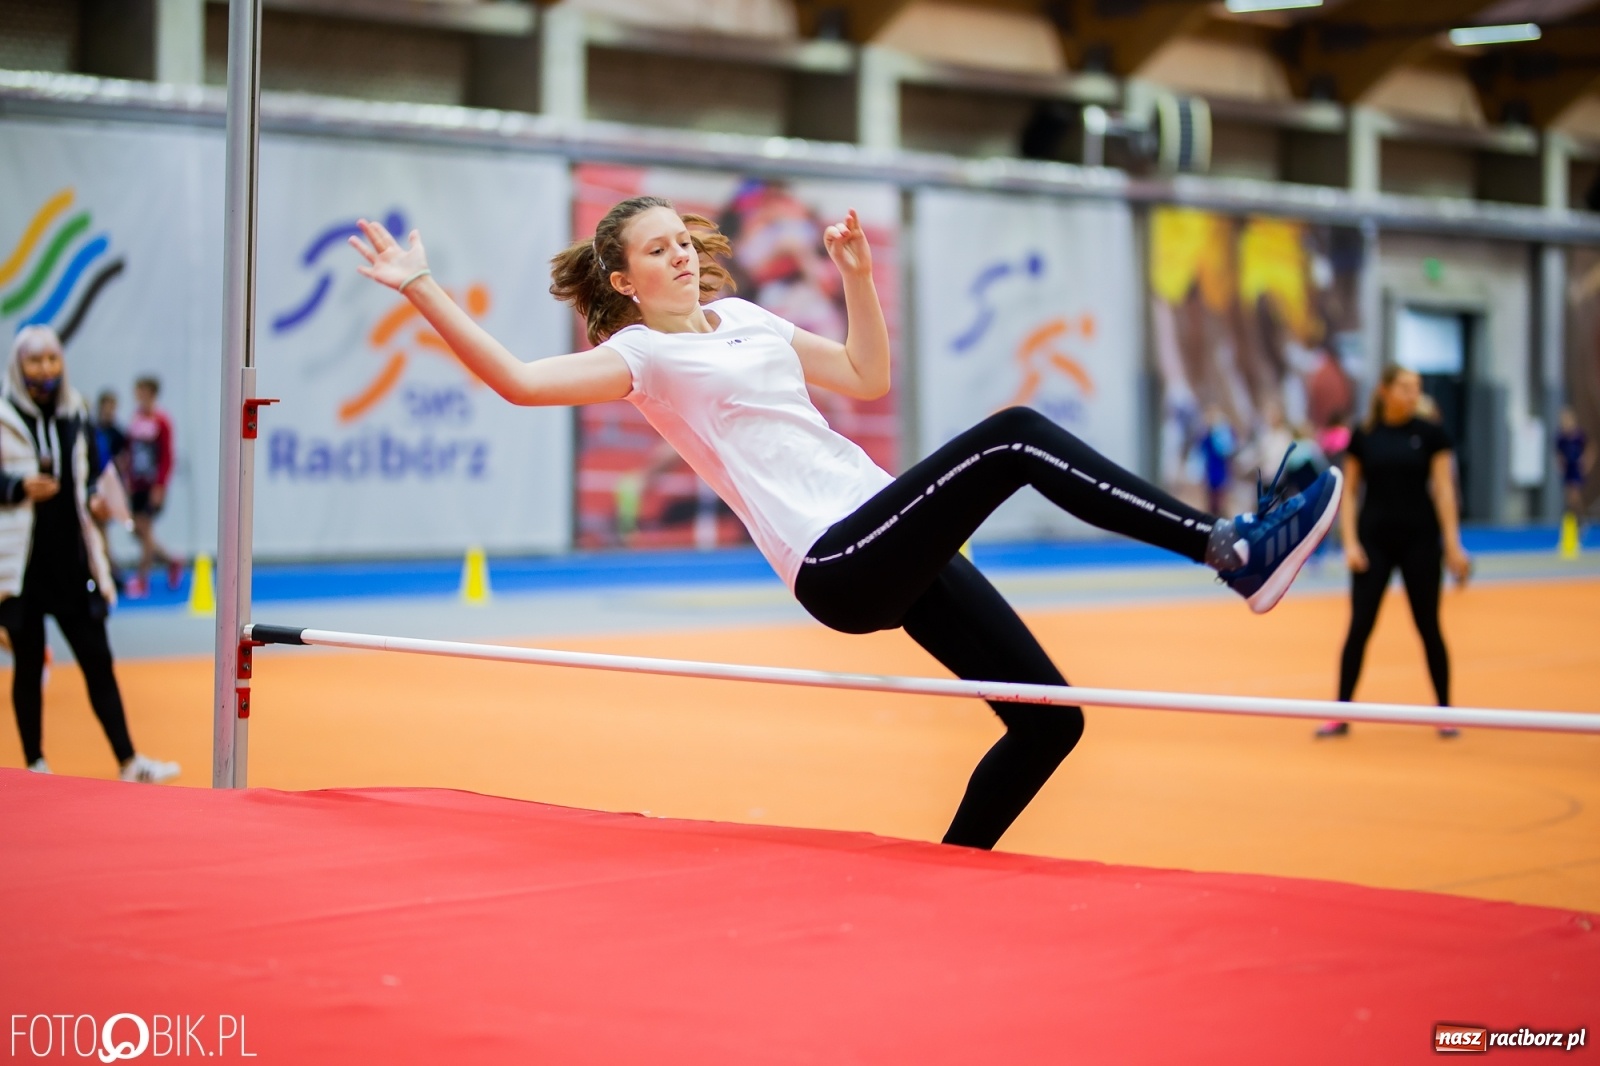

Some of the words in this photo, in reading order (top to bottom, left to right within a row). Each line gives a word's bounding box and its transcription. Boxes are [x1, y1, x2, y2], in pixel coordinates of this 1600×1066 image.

[936, 452, 982, 487] SPORTSWEAR
[1024, 444, 1071, 471] SPORTSWEAR
[1111, 487, 1156, 512] SPORTSWEAR
[856, 514, 899, 549] SPORTSWEAR
